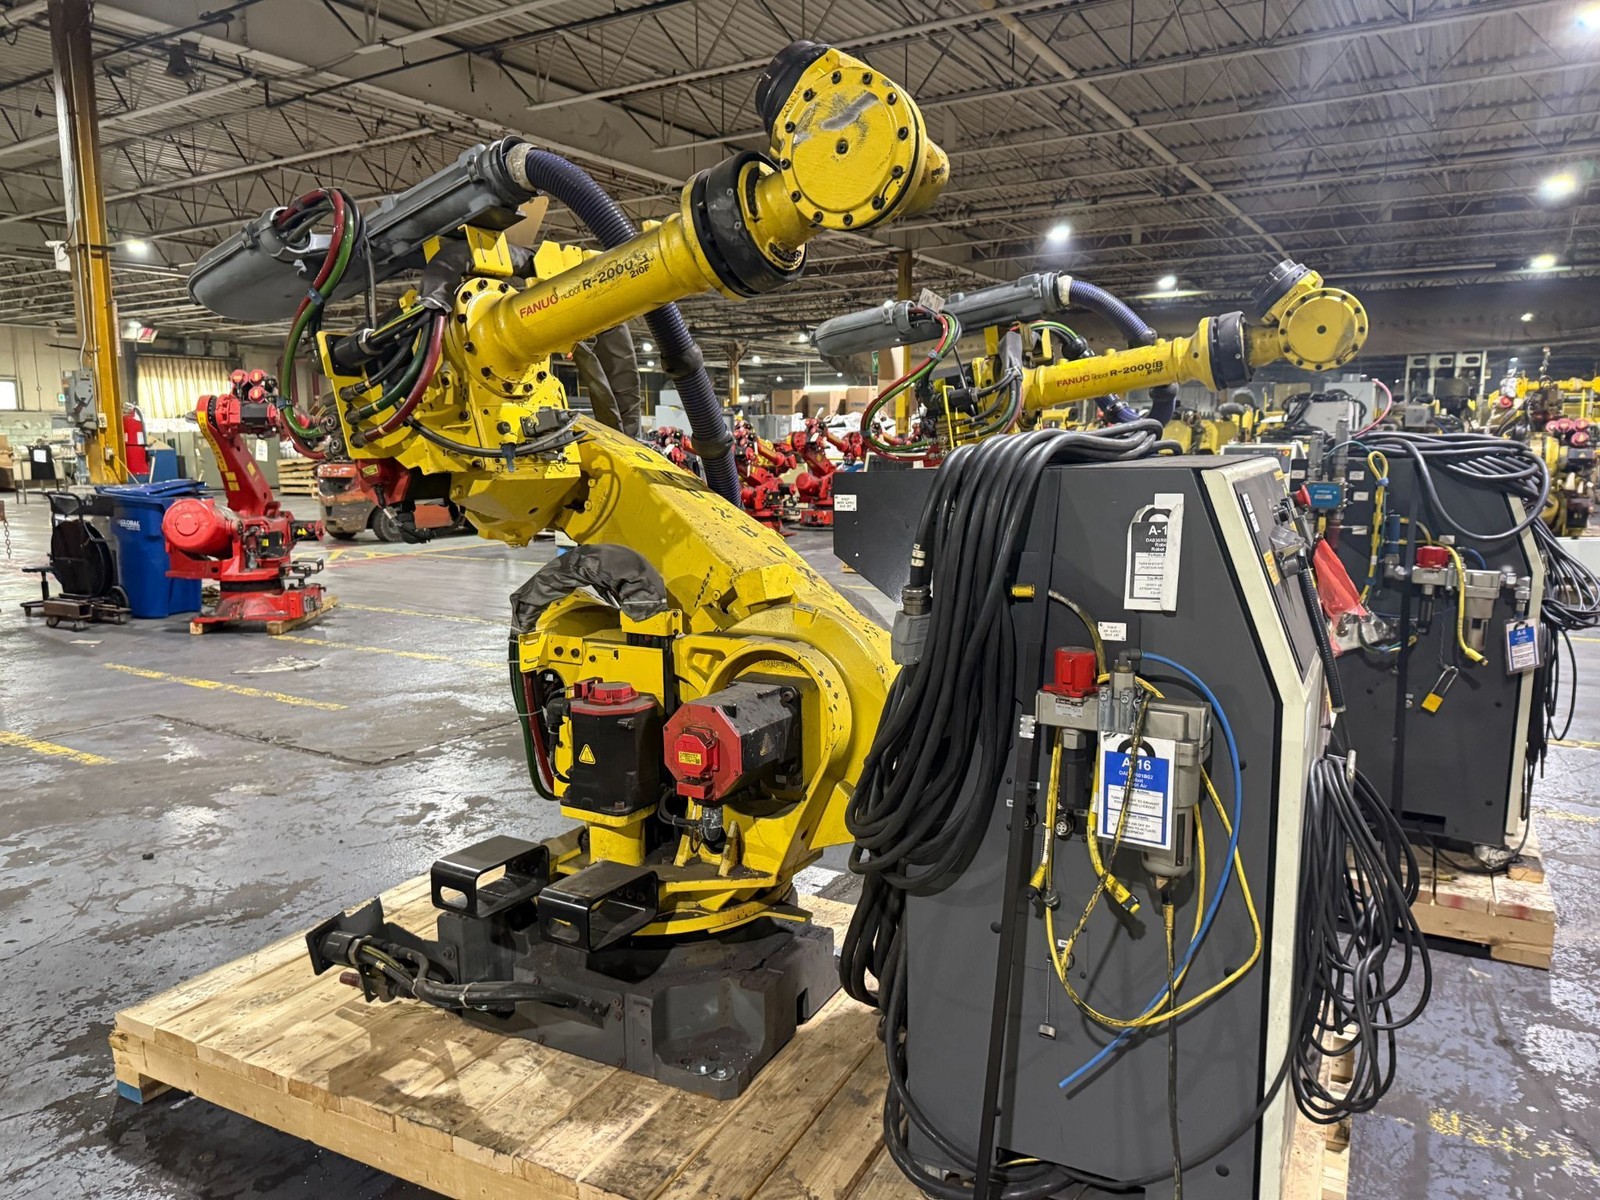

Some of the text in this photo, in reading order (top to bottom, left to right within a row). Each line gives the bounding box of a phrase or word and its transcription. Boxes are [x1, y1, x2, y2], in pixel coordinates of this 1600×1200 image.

[630, 264, 650, 279] 210F
[519, 292, 559, 319] FANUC
[1056, 374, 1090, 387] FANUC
[1149, 525, 1167, 535] A-1
[1122, 758, 1151, 770] A16
